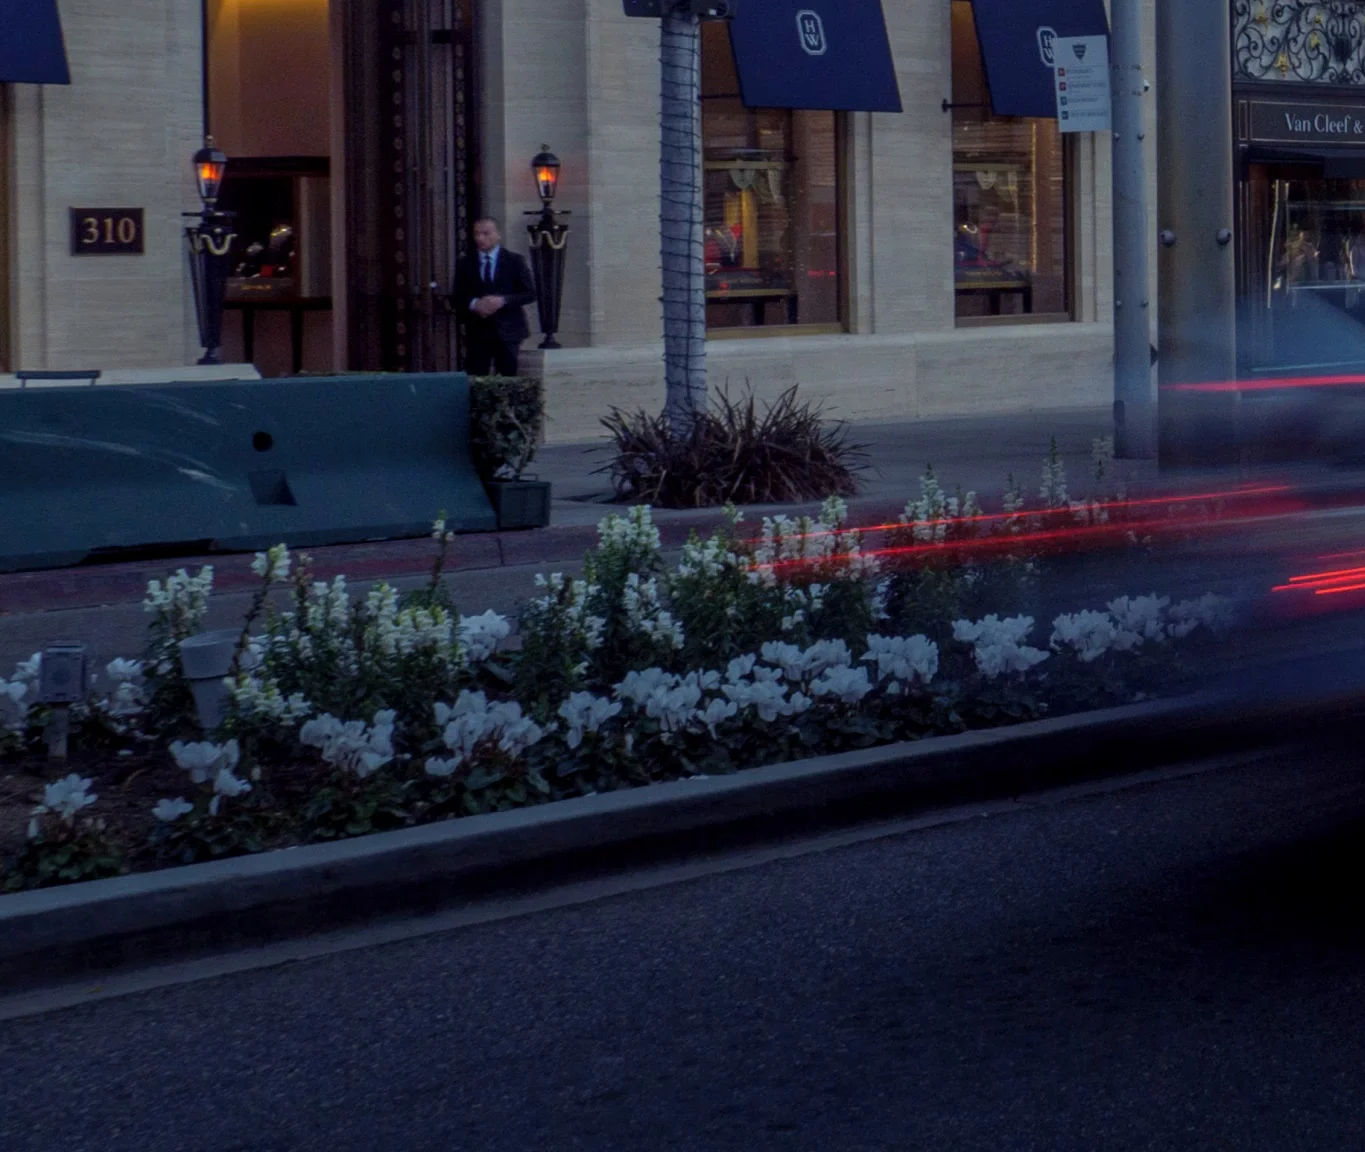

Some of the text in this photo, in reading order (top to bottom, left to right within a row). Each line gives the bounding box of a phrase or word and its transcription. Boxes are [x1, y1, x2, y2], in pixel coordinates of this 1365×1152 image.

[1285, 112, 1311, 133] Van
[1314, 113, 1352, 133] Cleef
[1353, 119, 1364, 134] &
[82, 217, 136, 244] 310
